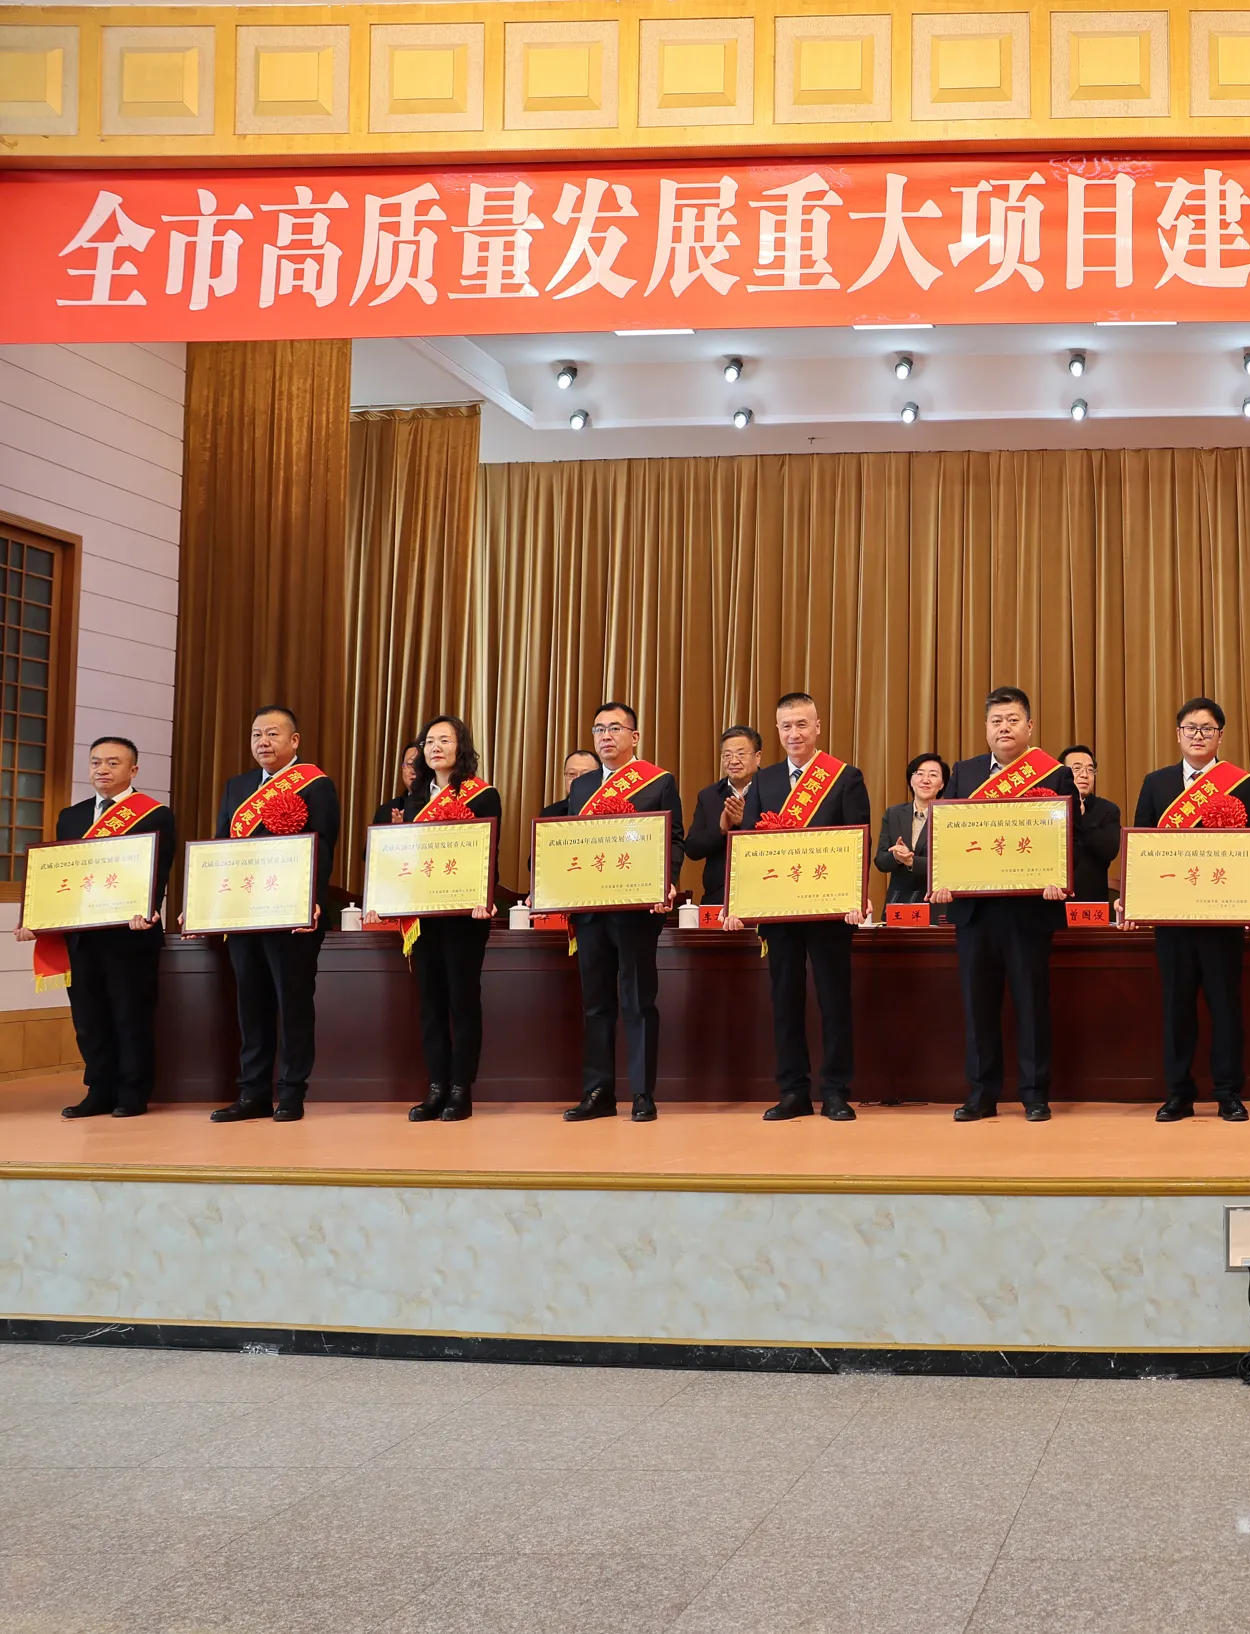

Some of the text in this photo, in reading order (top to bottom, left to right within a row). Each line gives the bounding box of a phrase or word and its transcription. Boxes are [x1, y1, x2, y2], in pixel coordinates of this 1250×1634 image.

[787, 766, 831, 821] 高质量发
[1164, 779, 1219, 828] 高质量发
[965, 836, 1033, 856] 二等奖
[398, 858, 458, 878] 三等奖
[566, 852, 632, 873] 三等奖
[56, 873, 119, 893] 三等奖
[762, 863, 829, 883] 二等奖
[1159, 866, 1228, 886] 一等奖
[218, 874, 279, 893] 三等奖
[892, 910, 922, 922] 王洋
